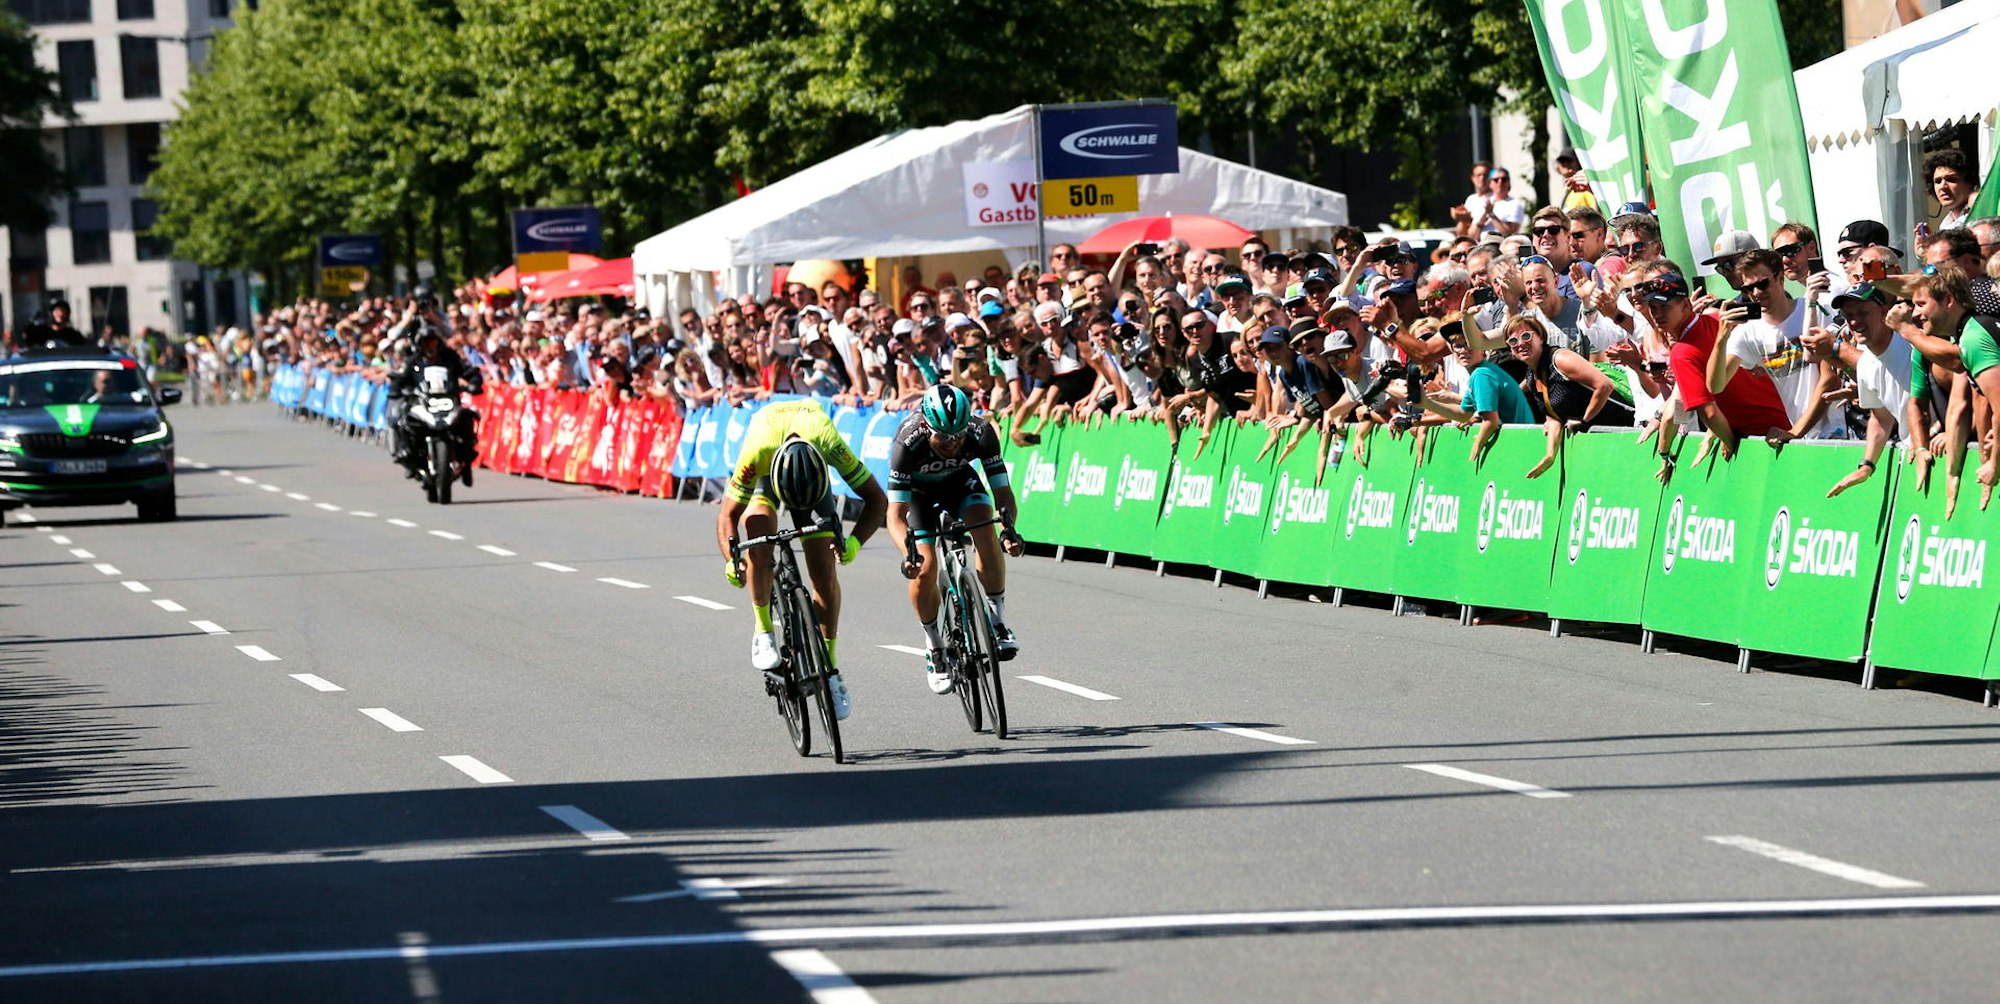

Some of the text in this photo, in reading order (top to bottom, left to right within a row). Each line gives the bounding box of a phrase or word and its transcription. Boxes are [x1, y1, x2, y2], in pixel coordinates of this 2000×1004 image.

[1077, 134, 1158, 148] SCHWALBE
[1069, 184, 1114, 206] 50 m
[920, 458, 969, 474] BORA
[1285, 479, 1330, 524] ŠKODA
[1358, 482, 1396, 528] ŠKODA
[1421, 485, 1460, 533] ŠKODA
[1495, 489, 1544, 540] ŠKODA
[1587, 497, 1640, 549] ŠKODA
[1681, 505, 1736, 564] ŠKODA
[1789, 517, 1860, 578] ŠKODA
[1918, 525, 1987, 589] ŠKODA
